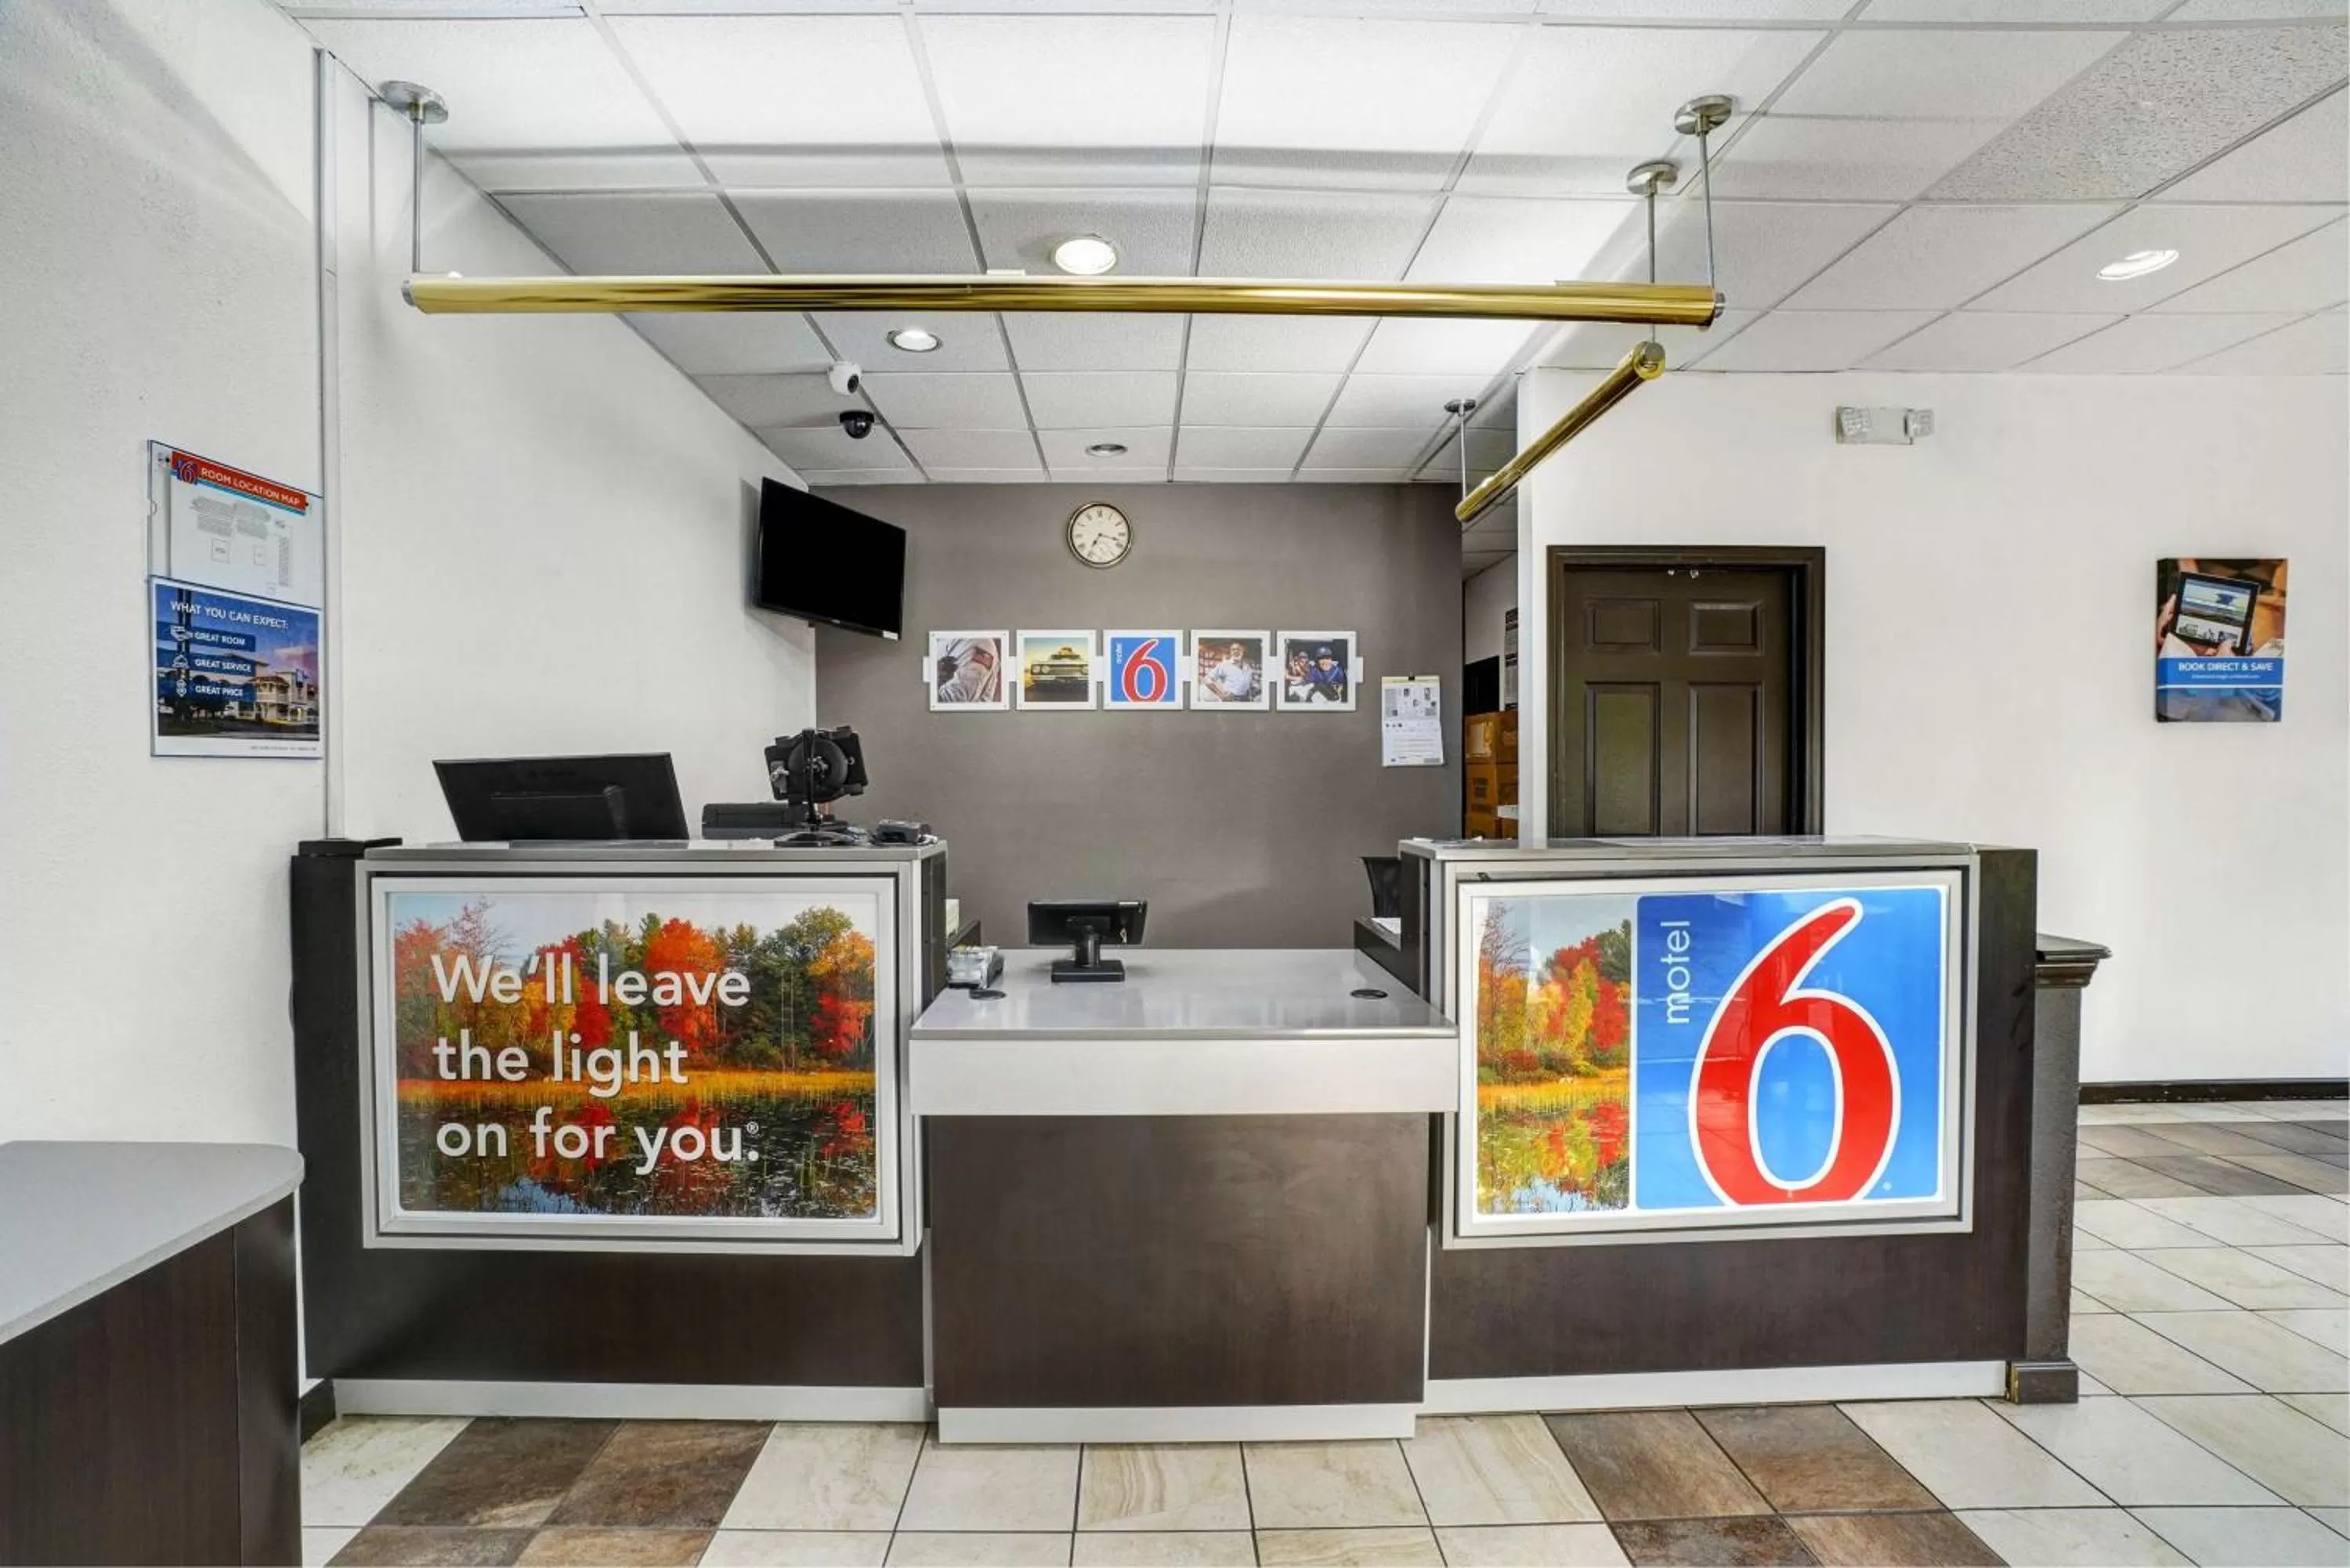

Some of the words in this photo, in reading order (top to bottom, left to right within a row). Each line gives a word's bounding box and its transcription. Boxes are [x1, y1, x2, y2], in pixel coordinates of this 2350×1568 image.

[201, 468, 231, 485] ROOM
[233, 478, 280, 500] LOCATION
[280, 493, 300, 506] MAP
[170, 601, 201, 614] WHAT
[204, 607, 226, 619] YOU
[229, 611, 251, 623] CAN
[253, 615, 289, 629] EXPECT:
[194, 631, 220, 642] GREAT
[222, 635, 246, 645] ROOM
[194, 658, 220, 669] GREAT
[222, 662, 251, 672] SERVICE
[1121, 638, 1168, 703] 6
[2178, 662, 2206, 671] BOOK
[2207, 662, 2240, 671] DIRECT
[2241, 663, 2249, 671] &
[2251, 662, 2274, 671] SAVE
[195, 685, 220, 695] GREAT
[222, 687, 244, 697] PRICE
[598, 952, 751, 1007] leave
[432, 1028, 529, 1082] the
[553, 1029, 689, 1098] light
[1660, 919, 1691, 1026] motel
[1688, 896, 1902, 1208] 6
[436, 1121, 507, 1158] on
[529, 1105, 616, 1159] for
